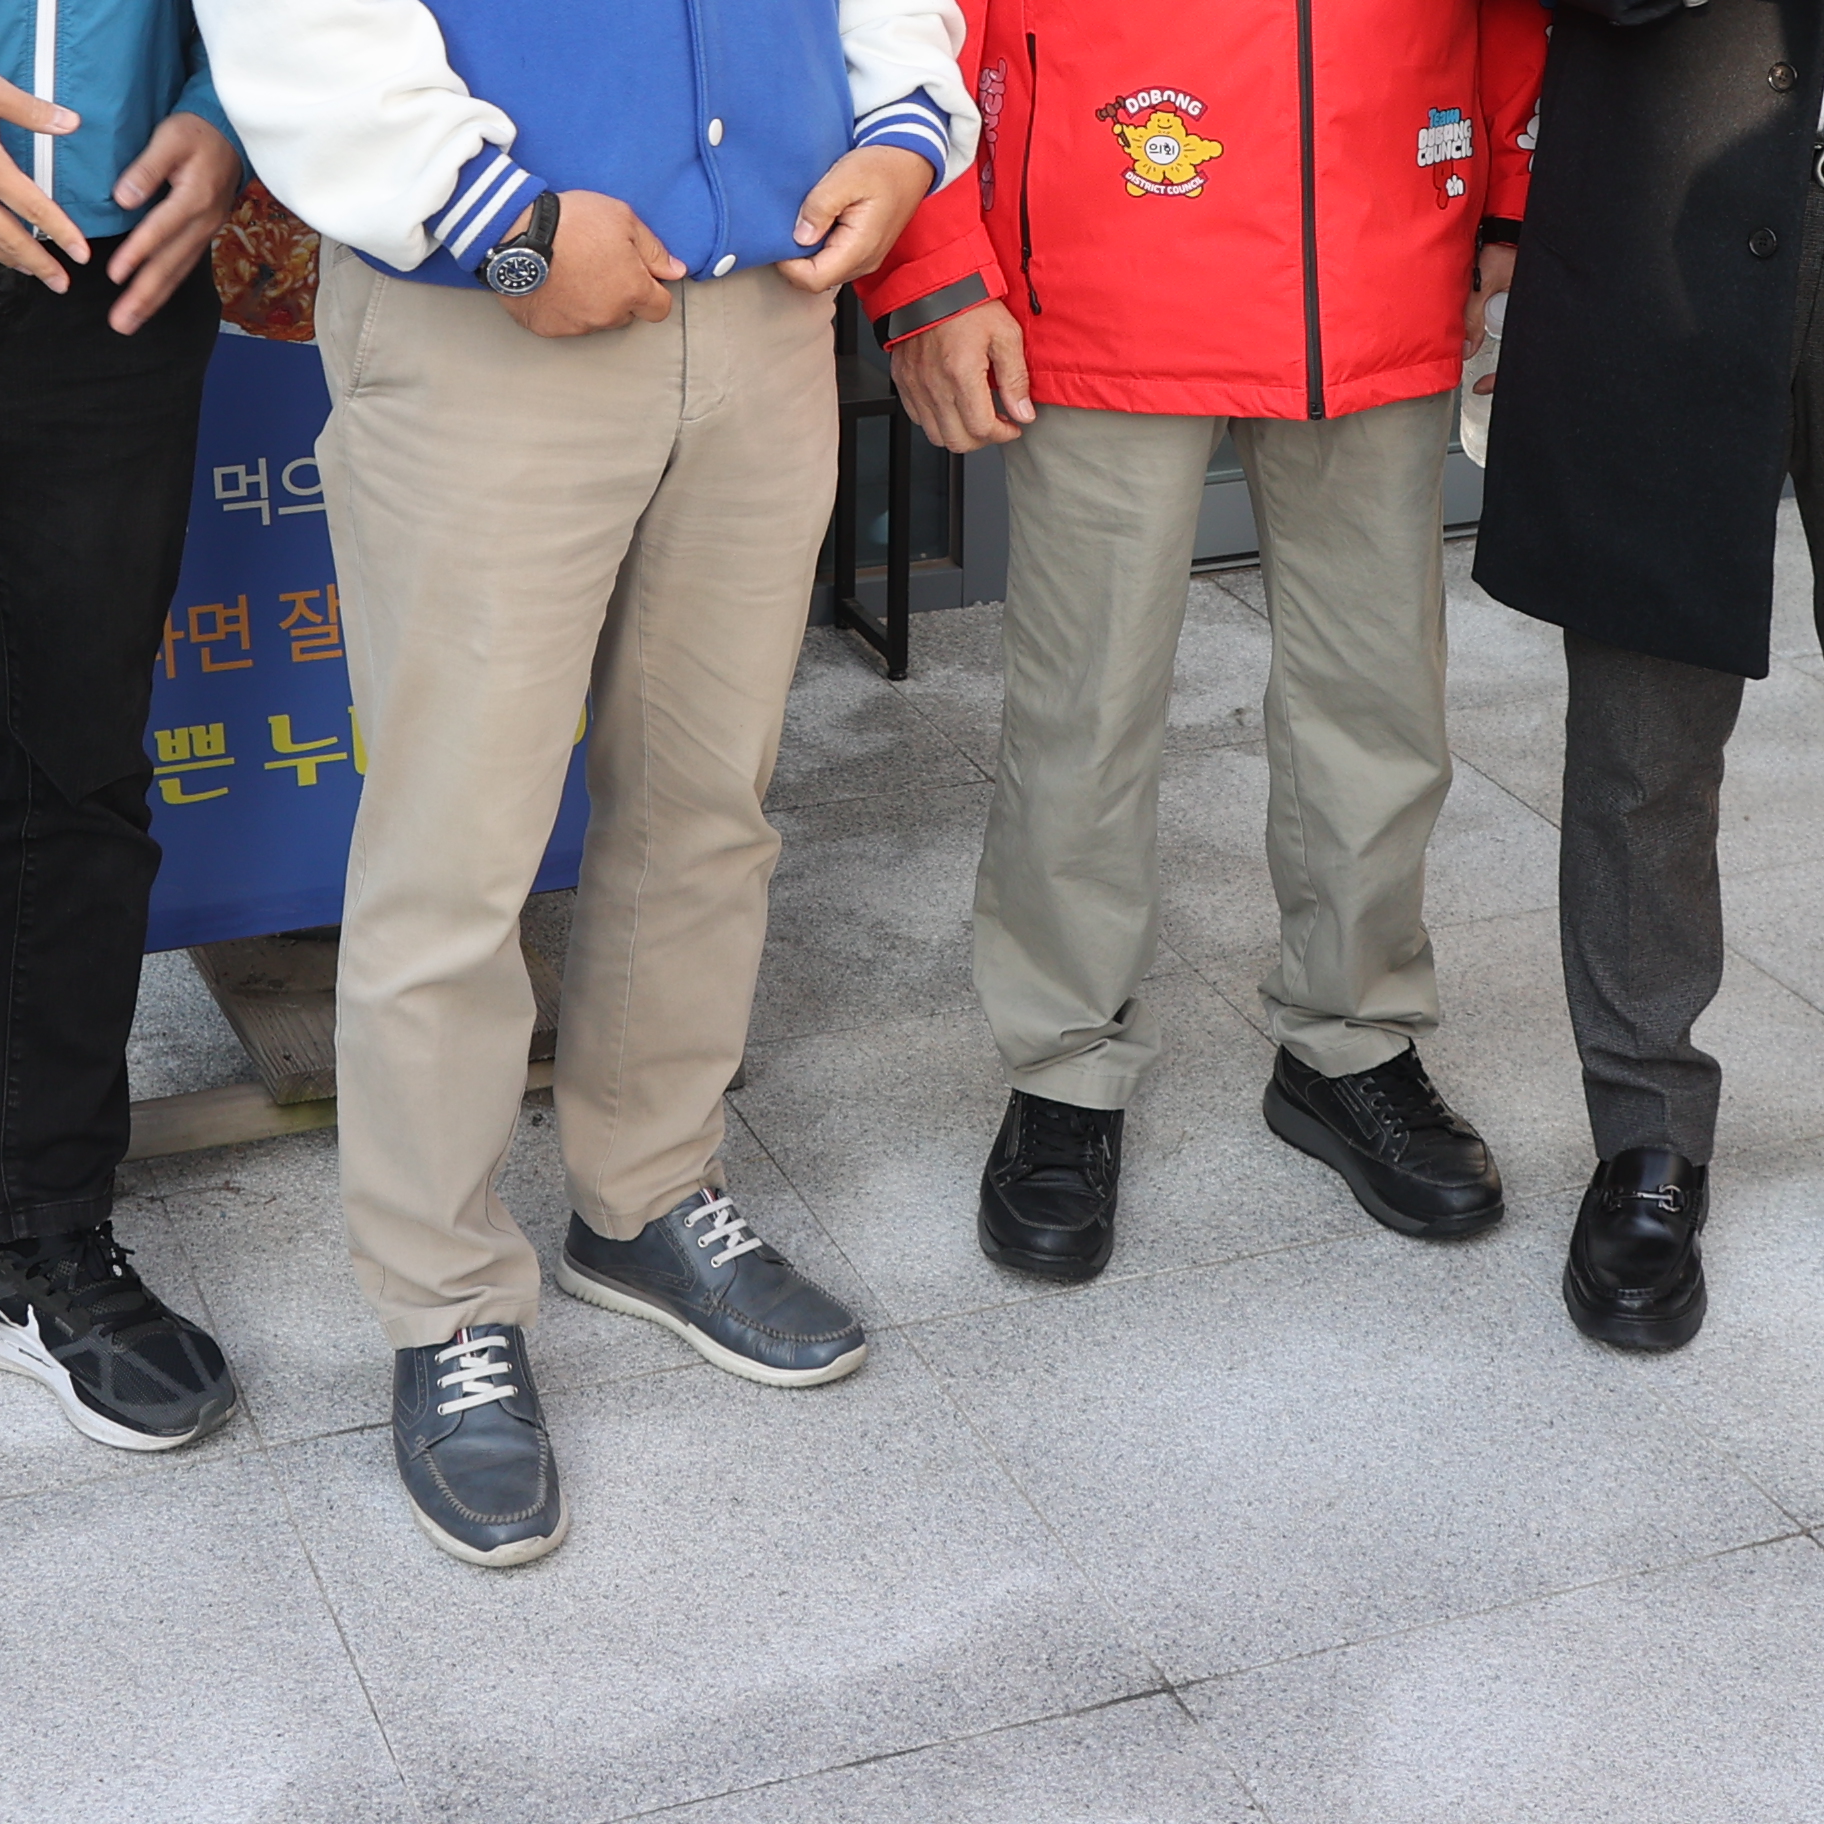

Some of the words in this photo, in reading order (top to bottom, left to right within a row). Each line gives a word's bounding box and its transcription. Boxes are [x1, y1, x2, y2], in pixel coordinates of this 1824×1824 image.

[1124, 88, 1203, 116] DOBONG
[1417, 118, 1473, 150] DOBONG
[1148, 141, 1175, 156] 의회
[1416, 137, 1474, 168] COUNCIL
[1124, 170, 1166, 195] DISTRICT
[1166, 176, 1205, 196] COUNCIL
